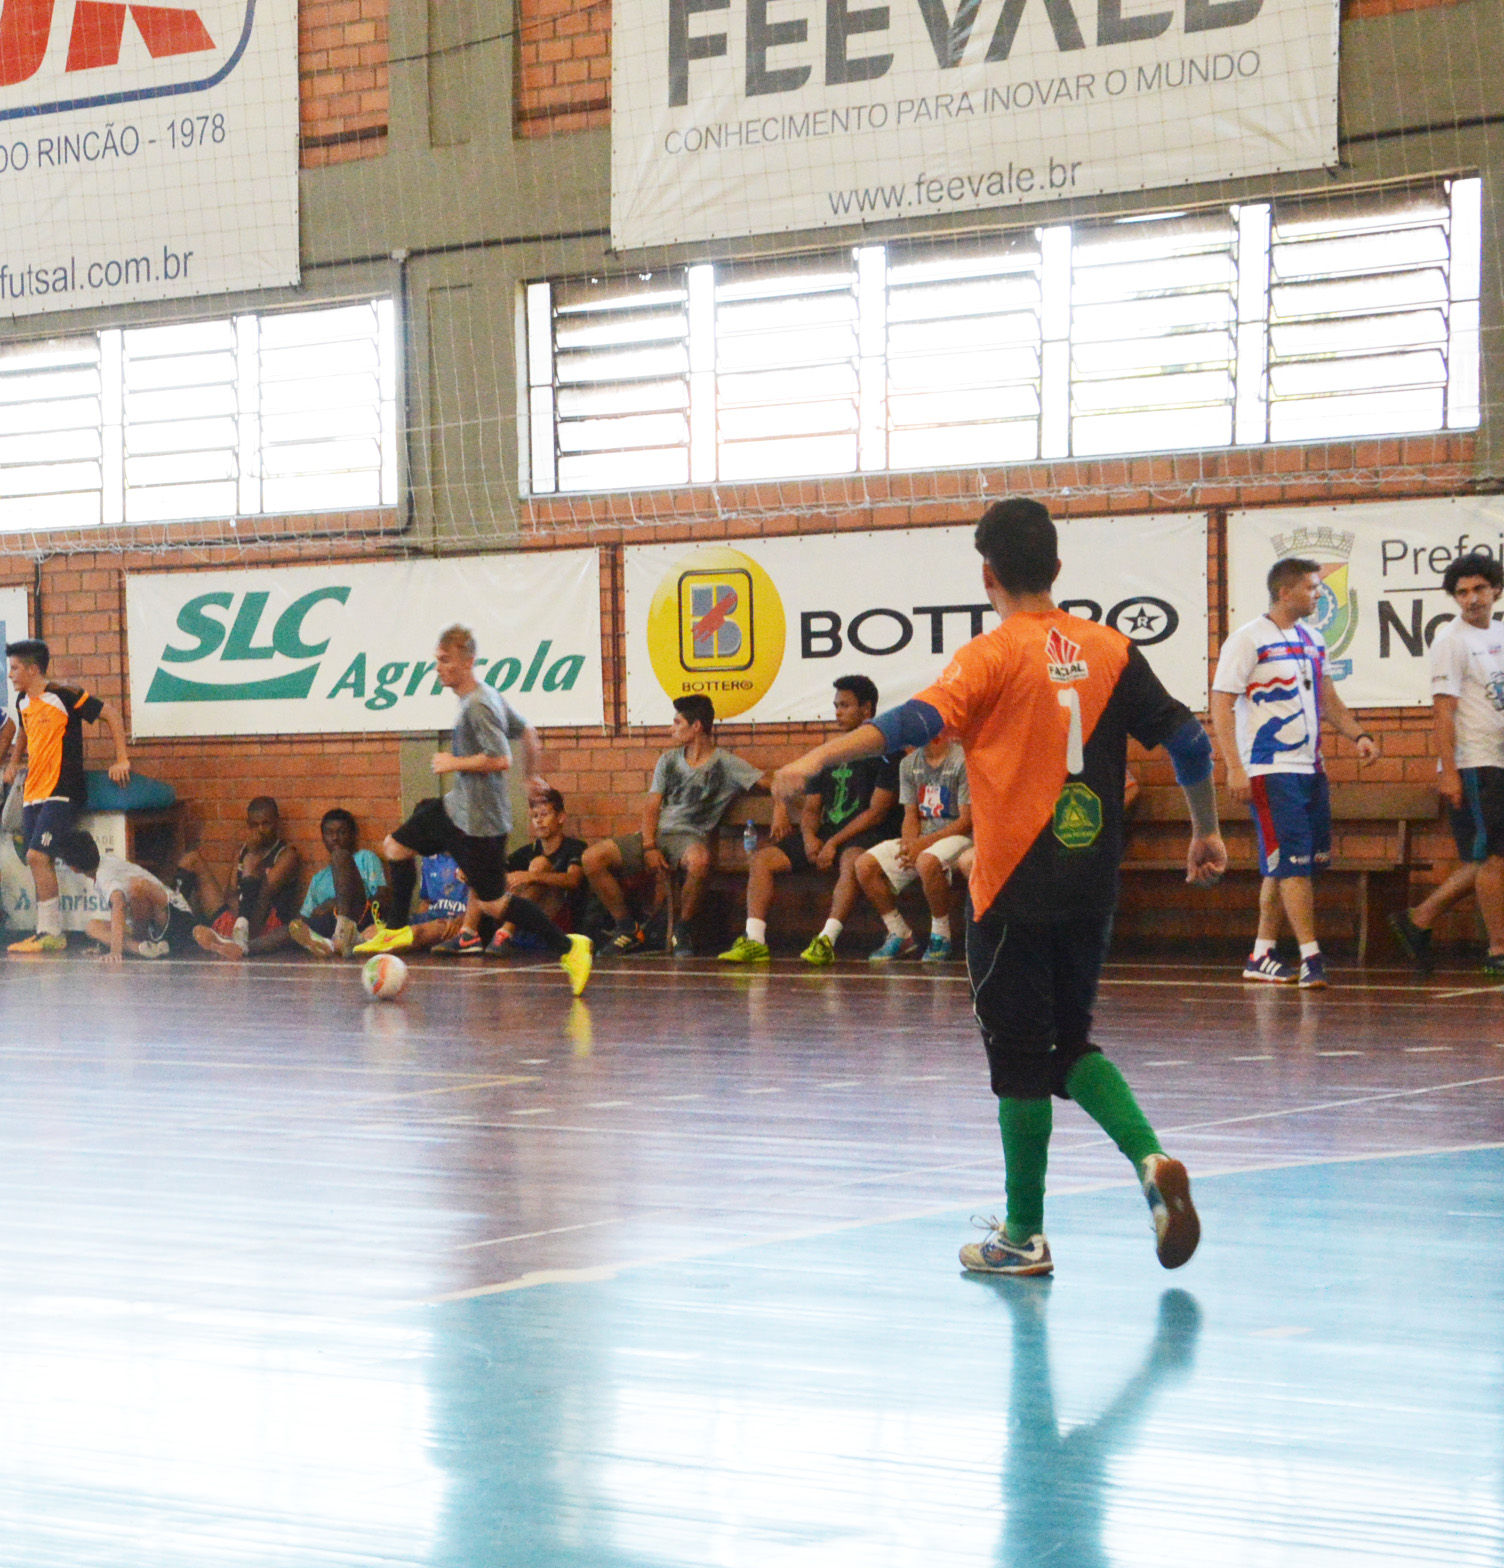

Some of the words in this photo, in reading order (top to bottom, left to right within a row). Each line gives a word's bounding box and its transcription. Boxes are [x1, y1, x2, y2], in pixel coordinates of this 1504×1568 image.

[668, 0, 1264, 108] FEEVA
[664, 103, 889, 155] CONHECIMENTO
[896, 91, 975, 125] PARA
[984, 73, 1096, 114] INOVAR
[1104, 68, 1128, 96] O
[1137, 50, 1261, 91] MUNDO
[37, 123, 140, 168] RINCÃO
[166, 113, 226, 149] 1978
[828, 156, 1083, 215] www.feevale.br
[161, 586, 352, 663] SLC
[799, 595, 1180, 659] BOTTRO
[326, 639, 587, 711] Agrola
[1057, 687, 1085, 775] 1
